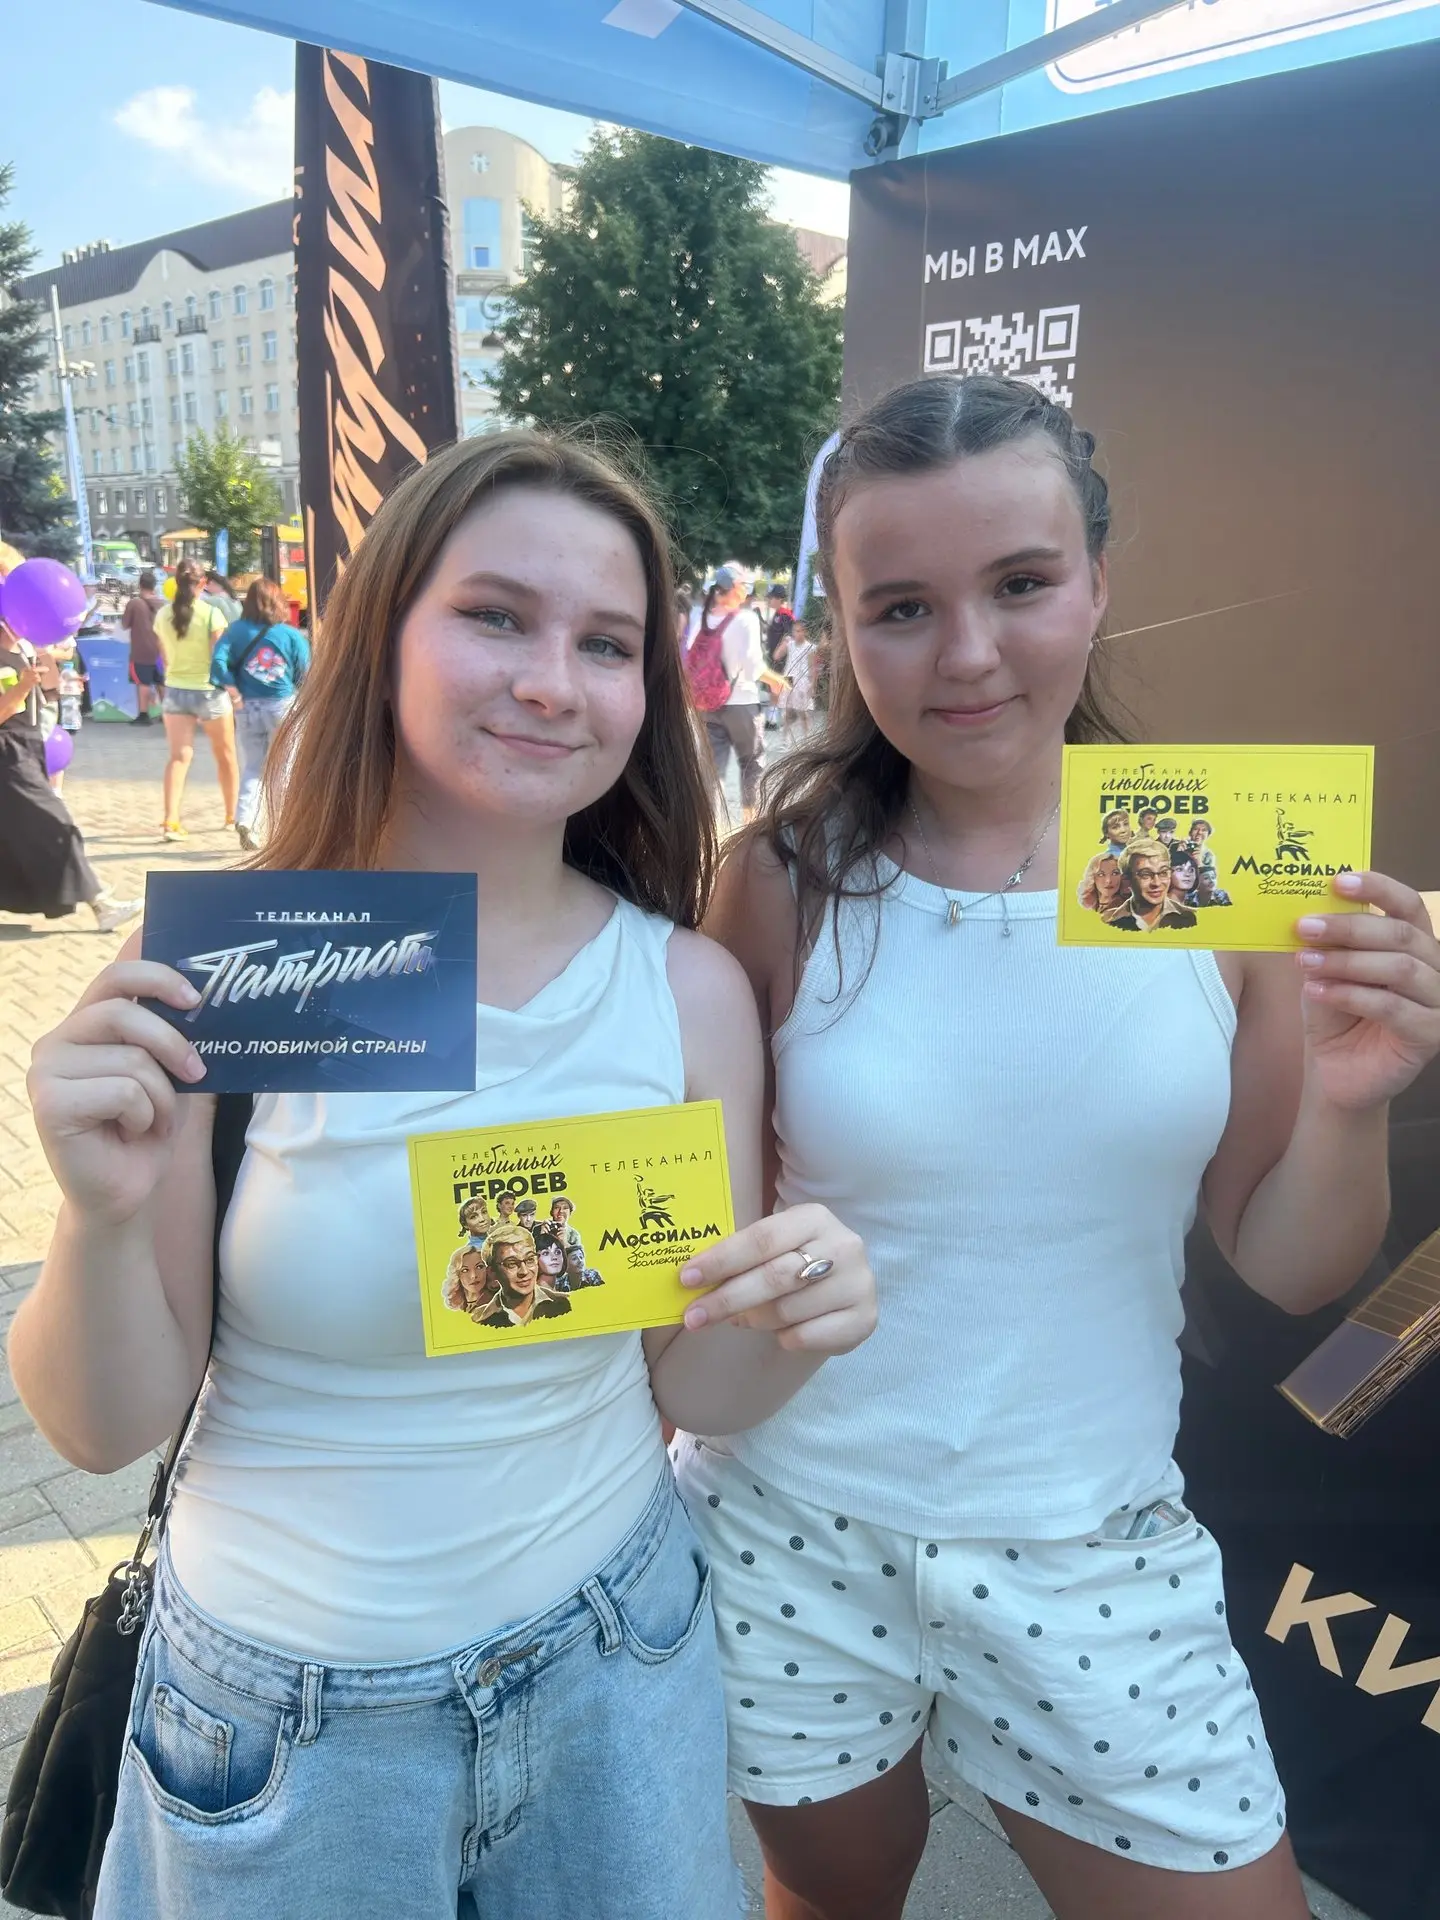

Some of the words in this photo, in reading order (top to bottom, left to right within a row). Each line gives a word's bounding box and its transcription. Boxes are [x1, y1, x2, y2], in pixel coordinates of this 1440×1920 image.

[924, 246, 976, 284] МЫ
[984, 241, 1004, 274] В
[1101, 763, 1208, 793] любимых
[1099, 795, 1209, 815] ГЕРОЕВ
[1233, 792, 1358, 804] ТЕЛЕКАНАЛ
[256, 911, 372, 923] ТЕЛЕКАНАЛ
[176, 929, 439, 1022] Патриот
[244, 1037, 349, 1055] ЛЮБИМОЙ
[352, 1039, 427, 1054] СТРАНЫ
[451, 1142, 560, 1162] ТЕЛЕКАНАЛ
[453, 1144, 563, 1179] любимых
[590, 1150, 713, 1174] ТЕЛЕКАНАЛ
[453, 1171, 568, 1204] ГЕРОЕВ
